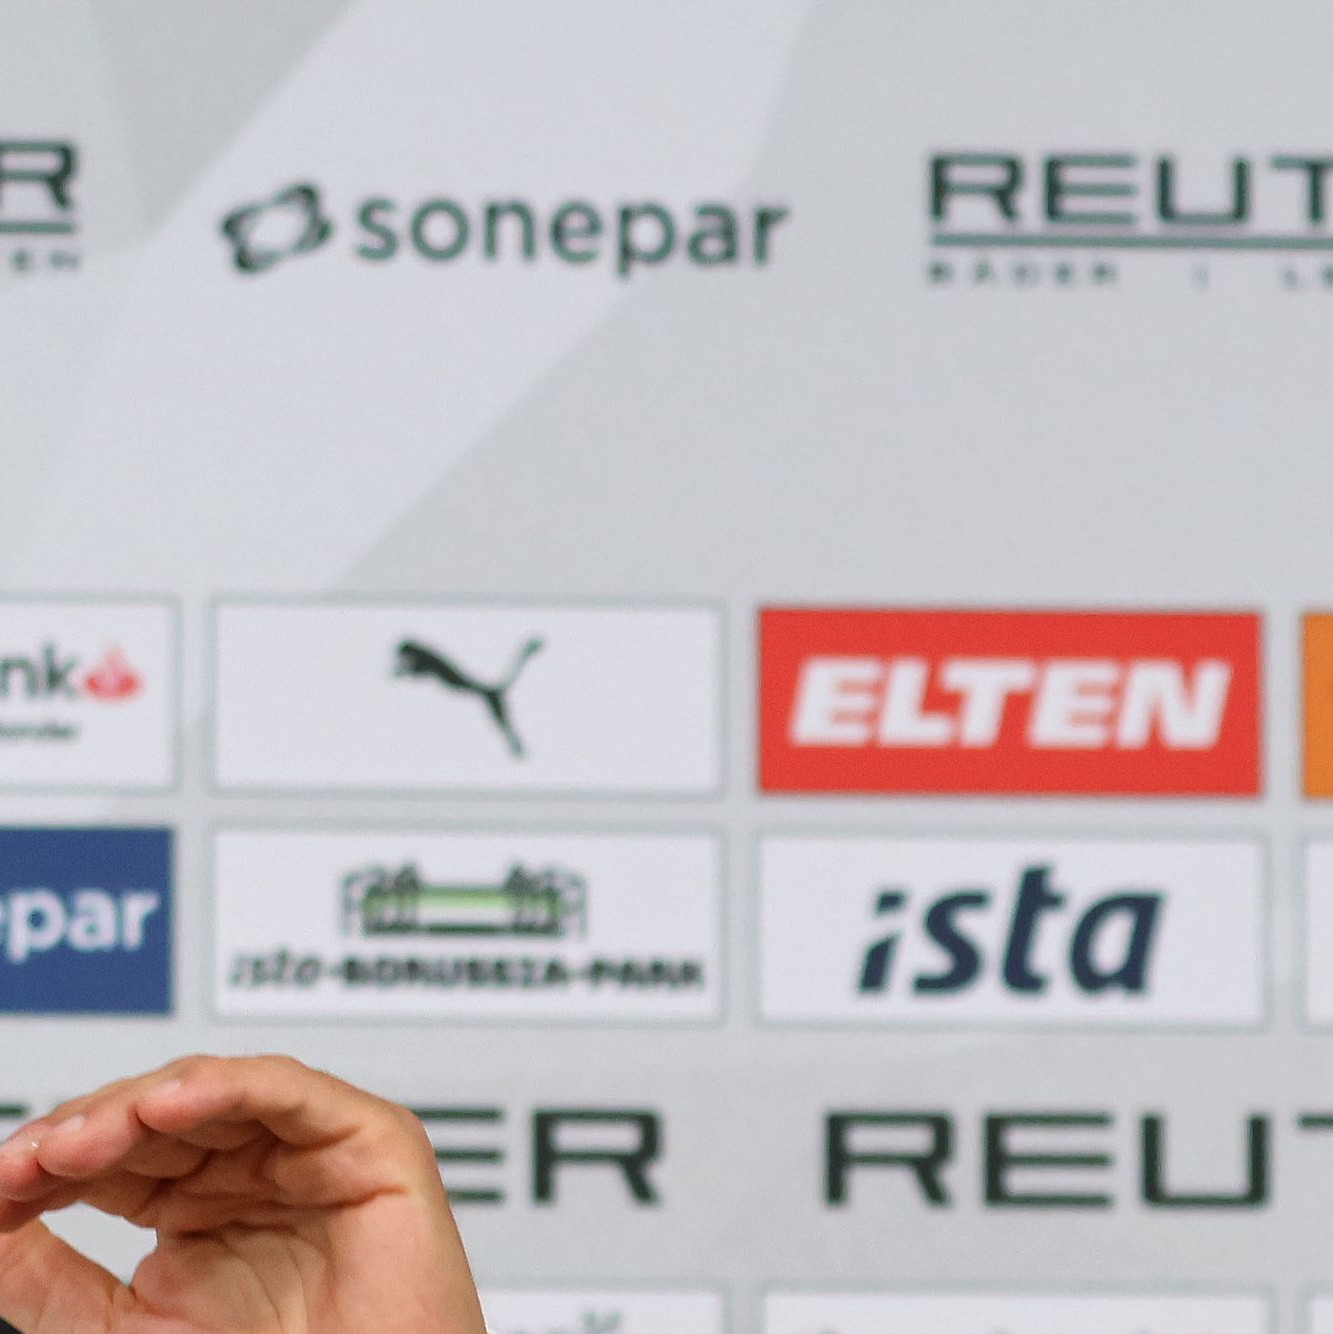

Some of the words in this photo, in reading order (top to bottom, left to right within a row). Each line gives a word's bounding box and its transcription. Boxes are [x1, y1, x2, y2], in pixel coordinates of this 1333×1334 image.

[355, 193, 790, 280] sonepar
[927, 255, 1121, 290] BÄDER
[788, 655, 1232, 751] ELTEN
[855, 861, 1169, 1000] ista
